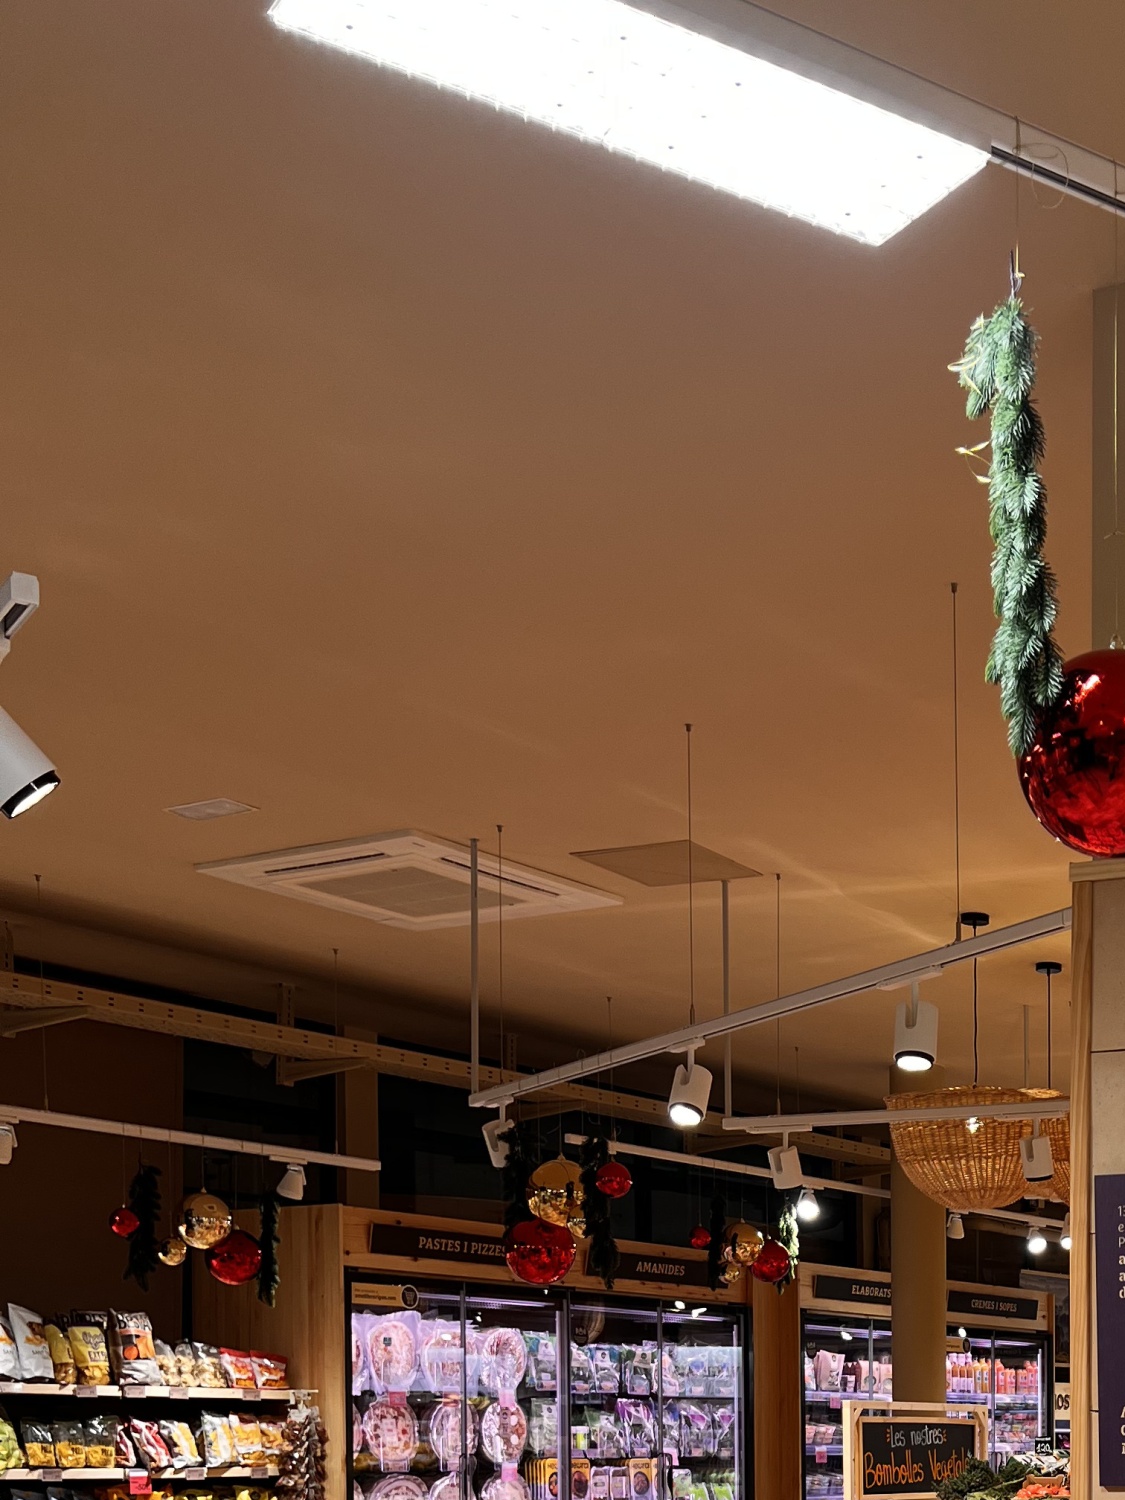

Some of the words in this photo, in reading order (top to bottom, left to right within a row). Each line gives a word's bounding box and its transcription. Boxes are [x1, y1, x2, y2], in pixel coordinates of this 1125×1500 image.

[419, 1236, 460, 1252] PASTES
[463, 1240, 469, 1252] I
[471, 1241, 506, 1257] PIZZES
[636, 1260, 685, 1276] AMANIDES
[1118, 1255, 1125, 1265] a
[852, 1284, 892, 1298] ELABORATS
[971, 1298, 995, 1311] CREMES
[999, 1302, 1018, 1313] SOPES
[890, 1425, 906, 1448] Les
[910, 1425, 944, 1446] nostres
[928, 1447, 970, 1481] Vegetal
